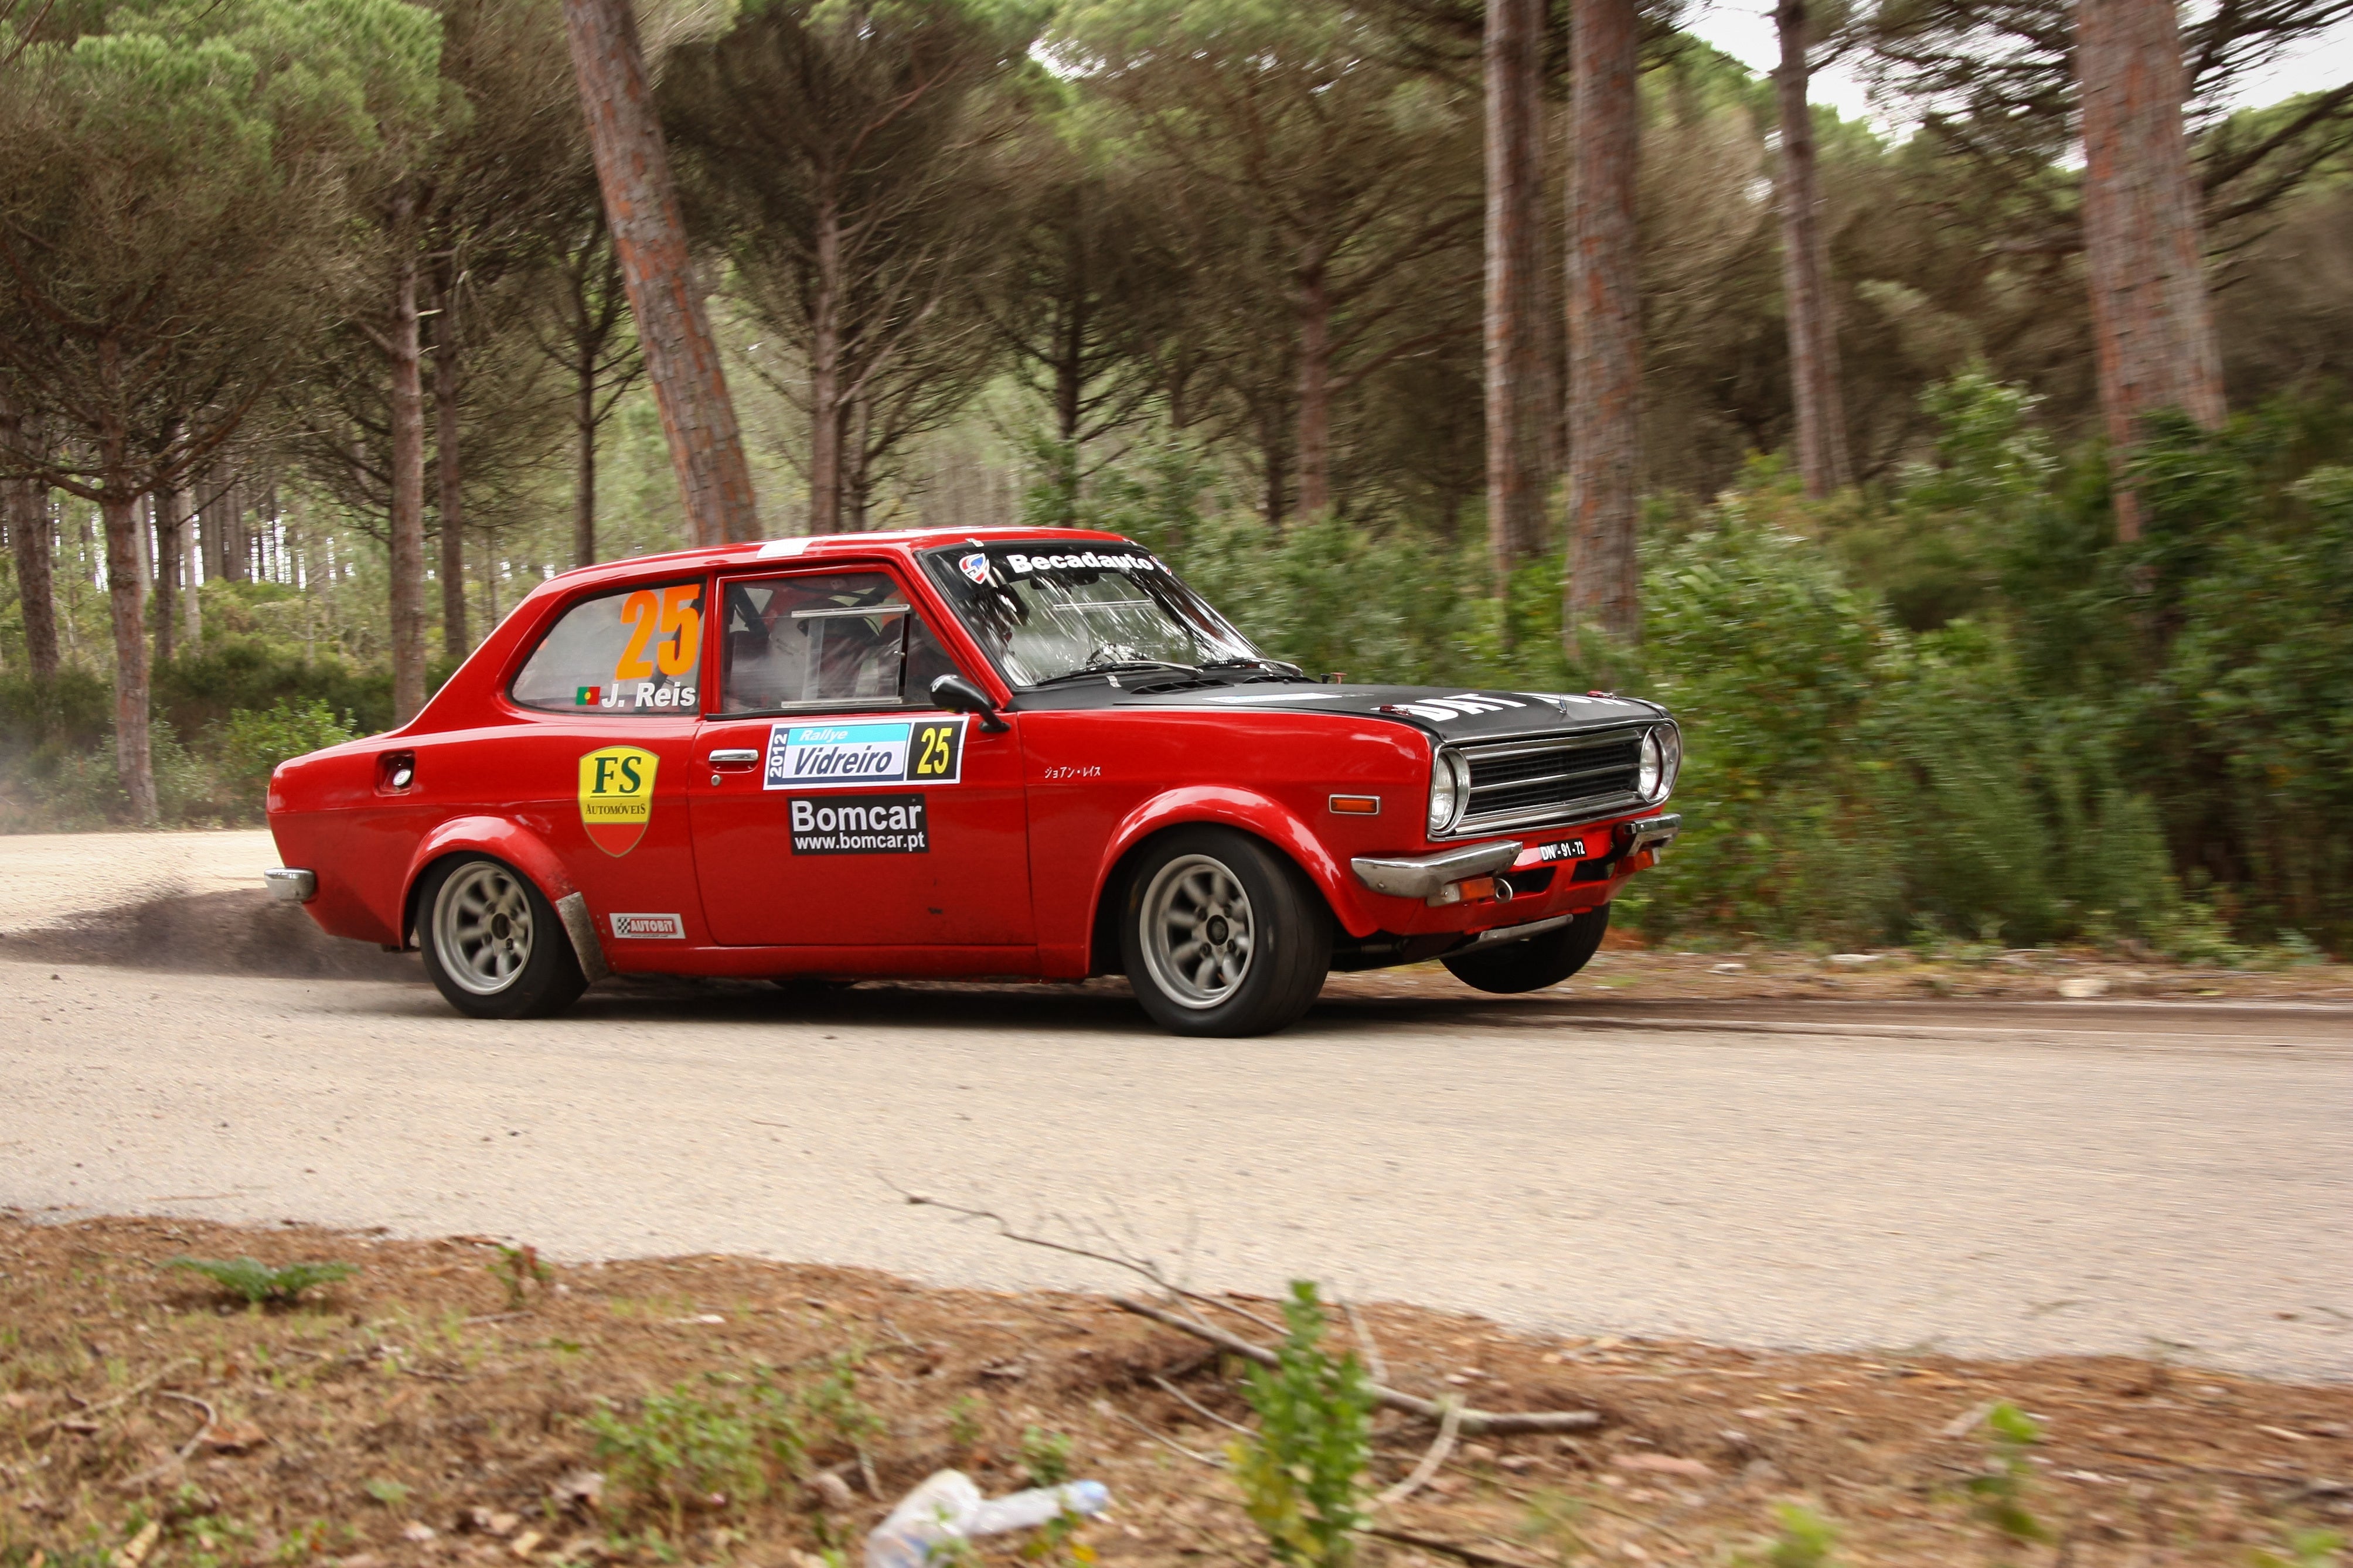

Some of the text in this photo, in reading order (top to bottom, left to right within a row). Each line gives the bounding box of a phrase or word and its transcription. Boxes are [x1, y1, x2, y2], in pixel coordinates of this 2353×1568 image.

[1006, 551, 1154, 574] Becadauto
[615, 584, 701, 680] 25
[601, 682, 696, 708] J. Reis
[799, 729, 849, 743] Rallye
[917, 727, 953, 774] 25
[769, 733, 788, 778] 2012
[794, 745, 893, 775] Vidreiro
[592, 756, 642, 793] FS
[585, 803, 646, 815] AUTOMÓVEIS
[791, 800, 922, 832] Bomcar
[795, 831, 925, 852] www.bomcar.pt
